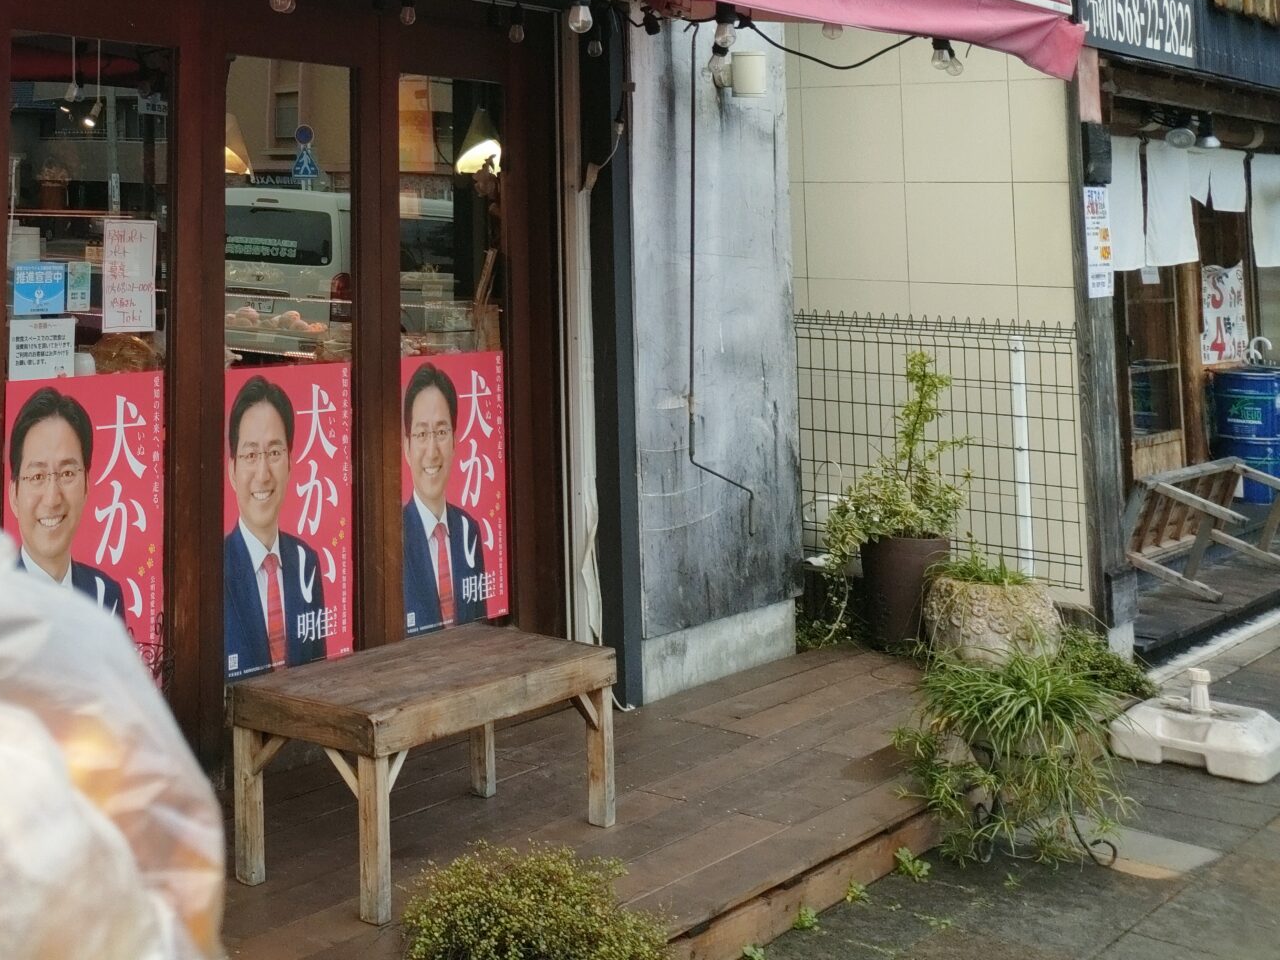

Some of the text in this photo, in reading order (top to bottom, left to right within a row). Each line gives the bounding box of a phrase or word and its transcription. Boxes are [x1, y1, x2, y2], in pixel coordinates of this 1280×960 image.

[16, 271, 62, 284] 推進宣言中
[459, 370, 494, 568] 犬かい
[296, 383, 338, 603] 犬かい
[463, 571, 494, 604] 明佳
[297, 607, 333, 643] 明佳
